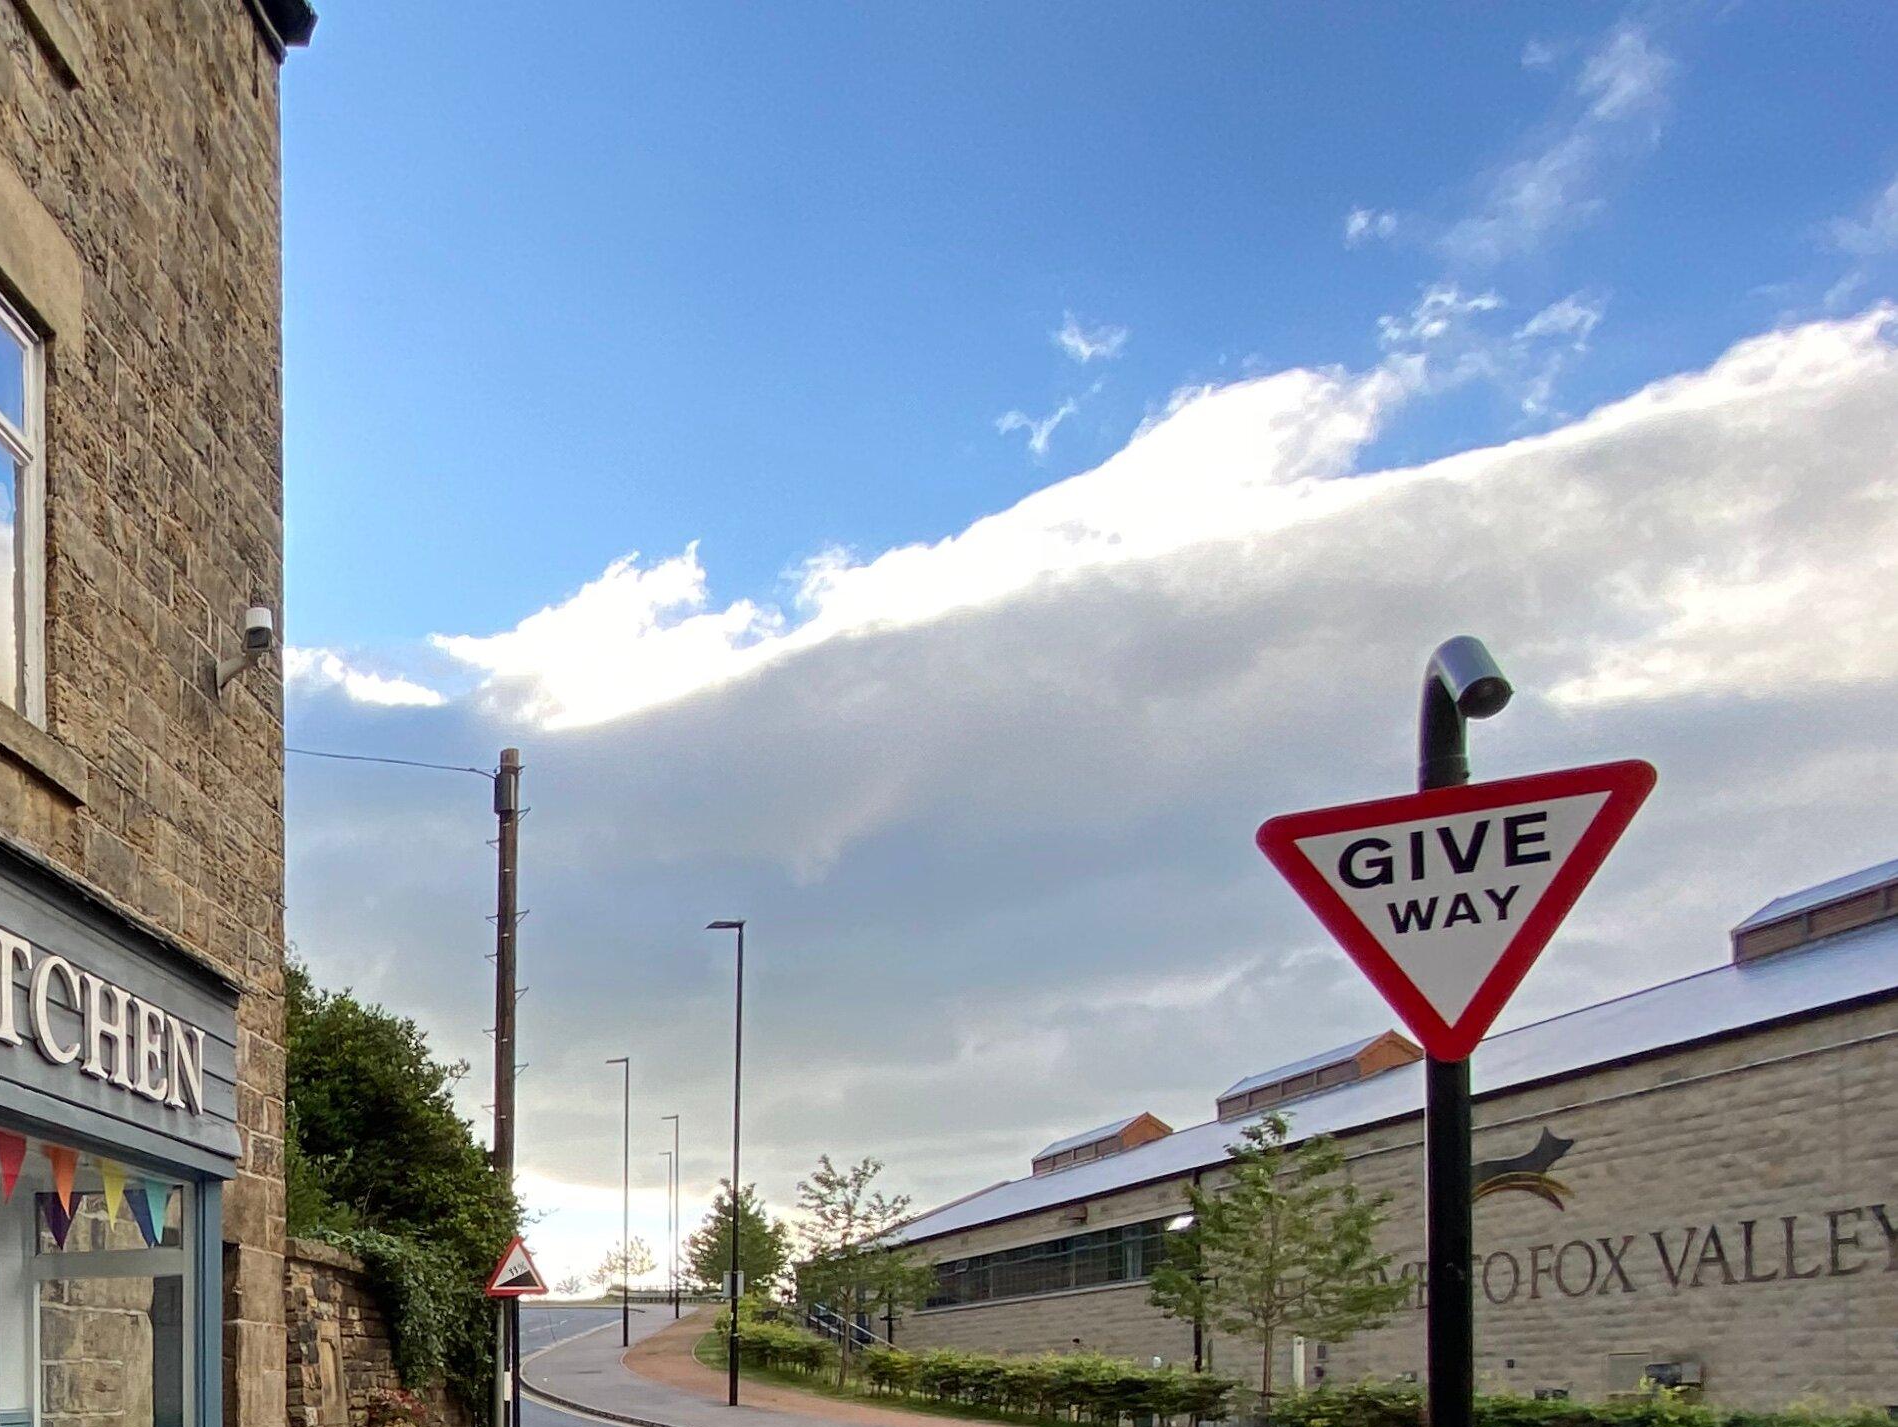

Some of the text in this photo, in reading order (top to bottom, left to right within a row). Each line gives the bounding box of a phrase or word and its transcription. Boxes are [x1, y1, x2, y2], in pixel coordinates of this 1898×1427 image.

[1337, 811, 1551, 890] GIVE
[1387, 884, 1520, 934] WAY
[1528, 1234, 1637, 1300] FOX
